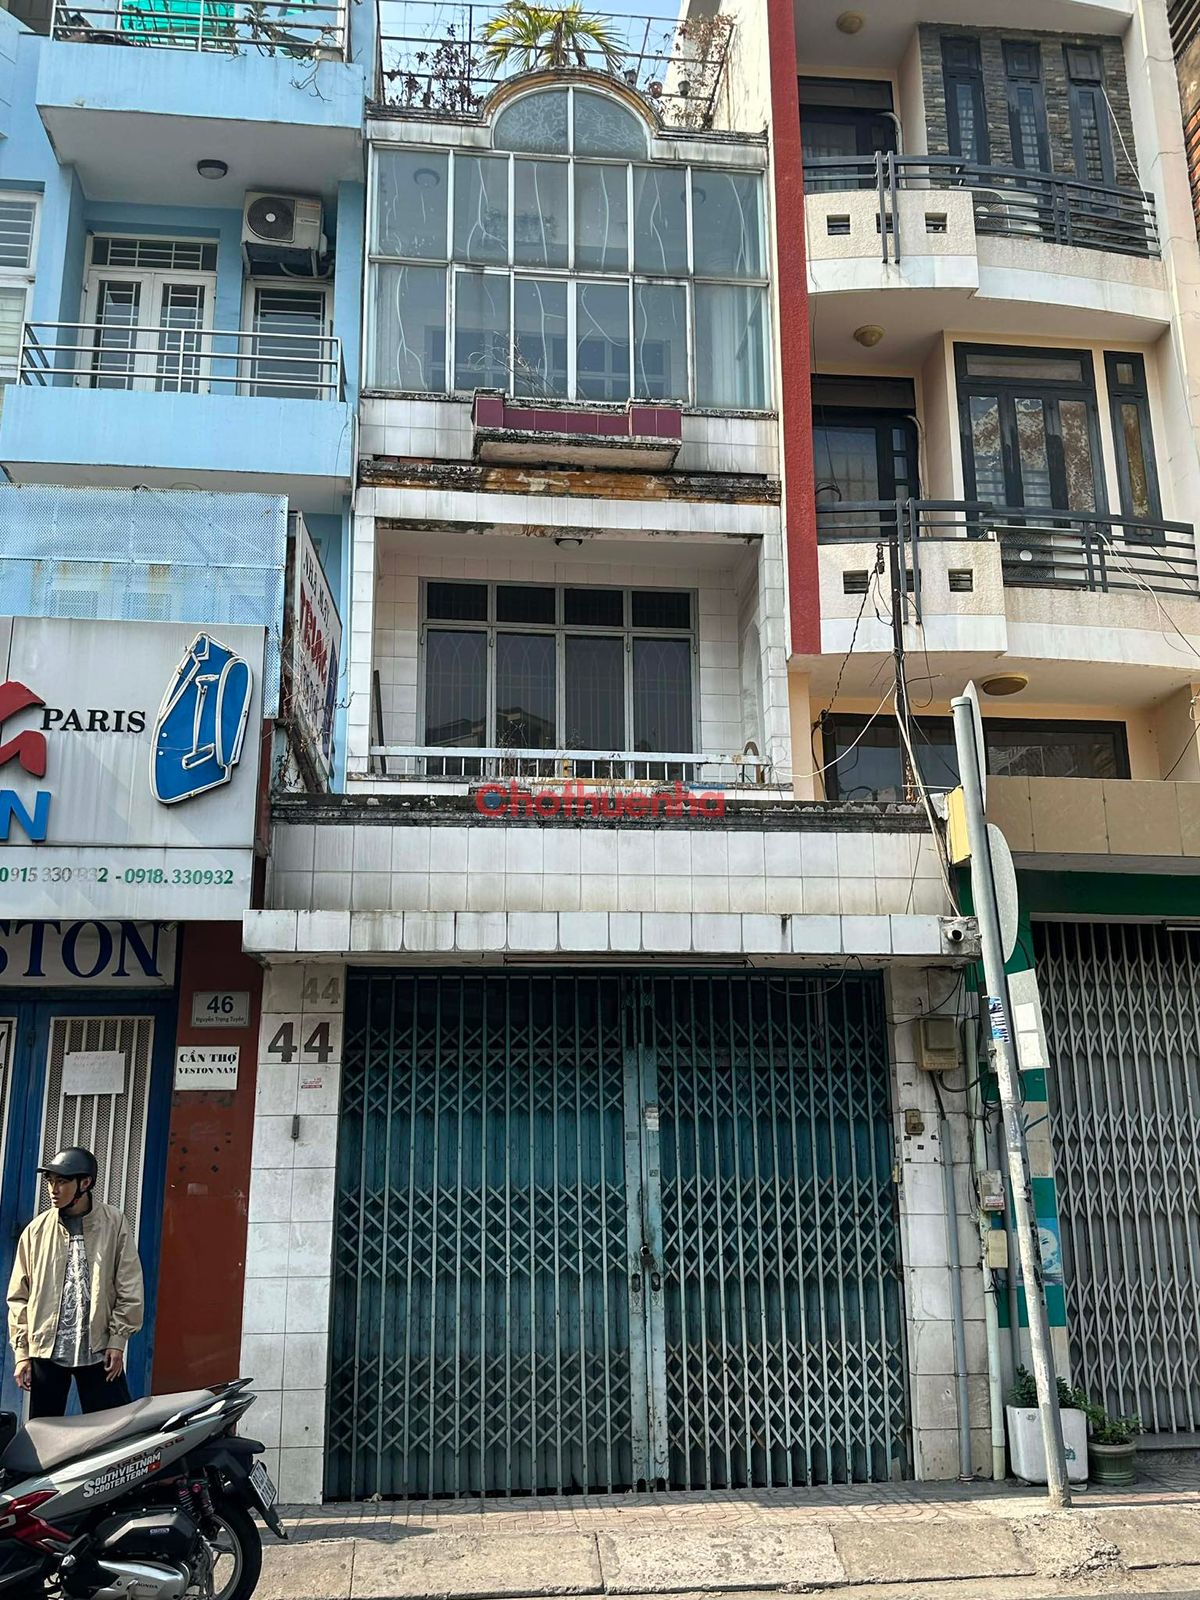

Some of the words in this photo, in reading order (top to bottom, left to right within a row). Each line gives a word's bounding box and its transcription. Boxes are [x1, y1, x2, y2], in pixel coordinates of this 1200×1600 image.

[40, 708, 146, 734] PARIS
[300, 976, 341, 1005] 44
[206, 995, 234, 1014] 46
[267, 1021, 334, 1063] 44
[178, 1067, 214, 1075] VESTON
